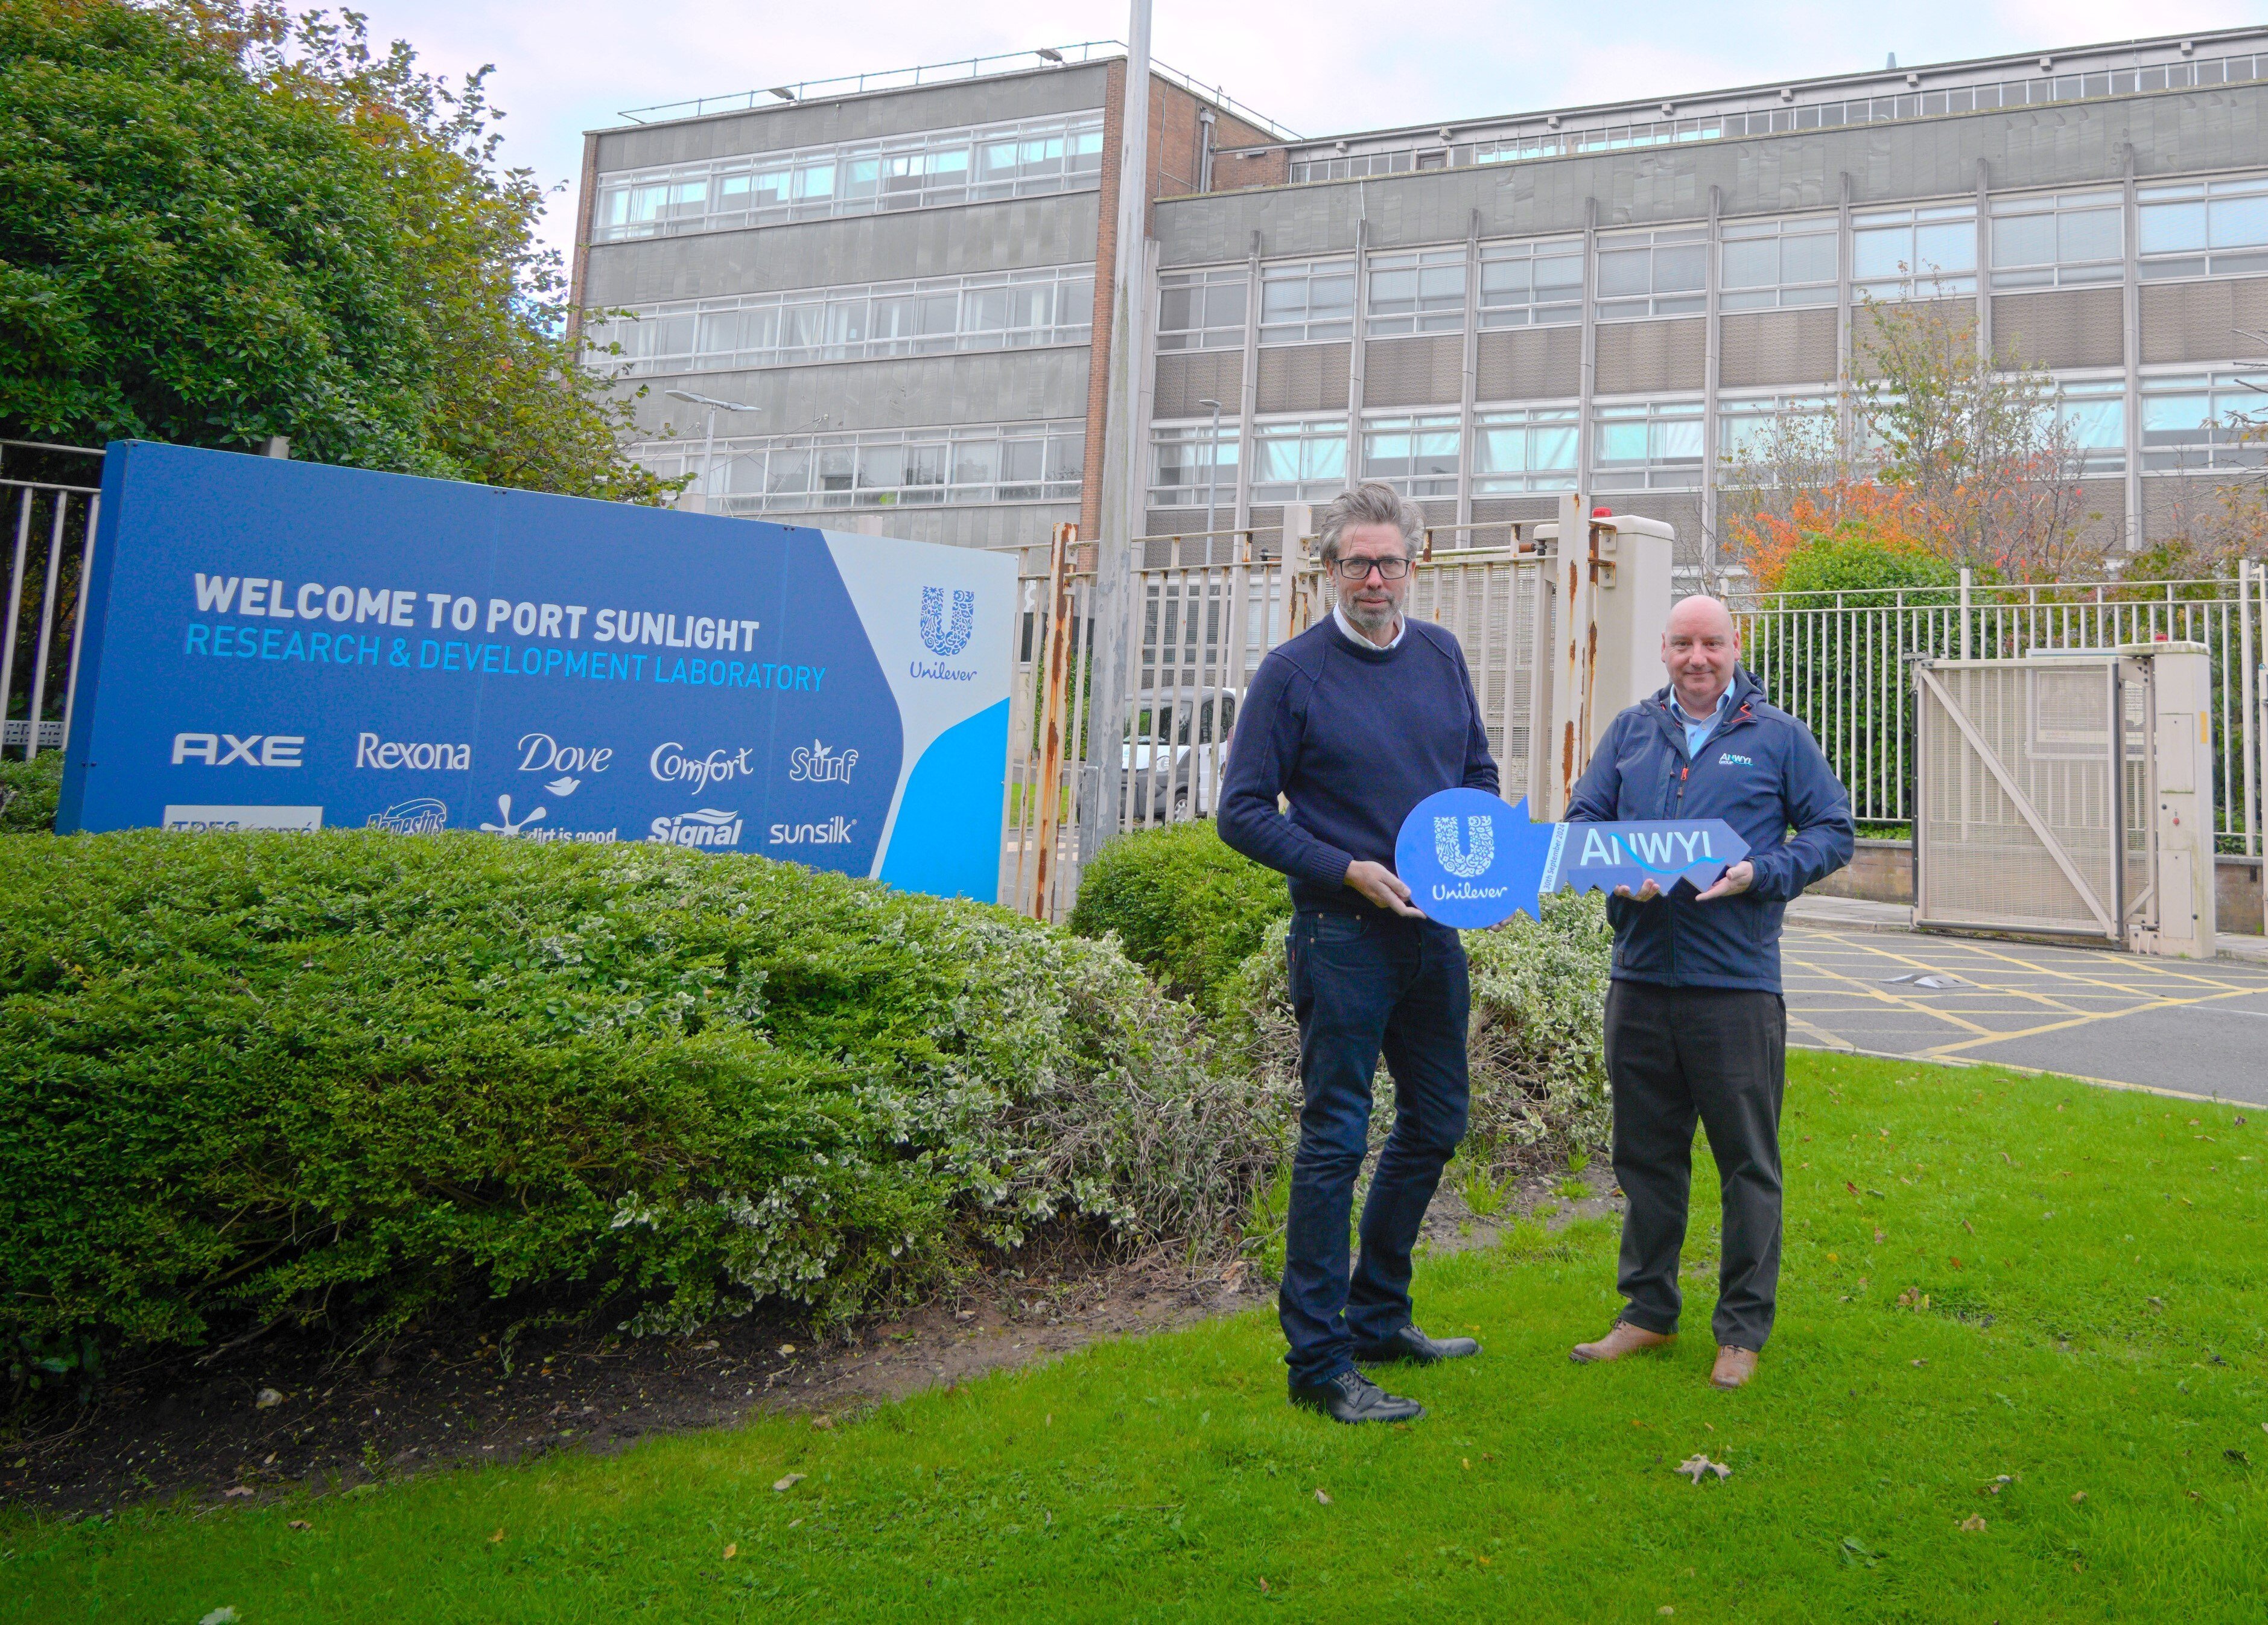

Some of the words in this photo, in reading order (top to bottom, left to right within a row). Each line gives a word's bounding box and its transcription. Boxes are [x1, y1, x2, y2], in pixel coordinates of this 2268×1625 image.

[195, 573, 418, 628] WELCOME
[427, 593, 477, 632] TO
[486, 599, 588, 640] PORT
[594, 608, 760, 652] SUNLIGHT
[186, 623, 381, 666] RESEARCH
[389, 637, 411, 669] &
[419, 639, 648, 682] DEVELOPMENT
[654, 655, 827, 692] LABORATORY
[910, 661, 977, 682] Unilever
[172, 733, 305, 768] AXE
[356, 733, 471, 771] Rexona
[518, 733, 613, 773] Dove
[789, 745, 859, 785] Surf
[1720, 752, 1753, 766] ANWYL
[650, 742, 754, 796] Comfort
[559, 827, 573, 842] is
[648, 815, 743, 847] Signal
[769, 816, 852, 844] sunsilk
[1555, 823, 1565, 839] 2024
[1547, 839, 1561, 875] September
[1580, 828, 1726, 874] ANWYL
[1432, 882, 1508, 900] Unilever
[1543, 875, 1553, 890] 30th
